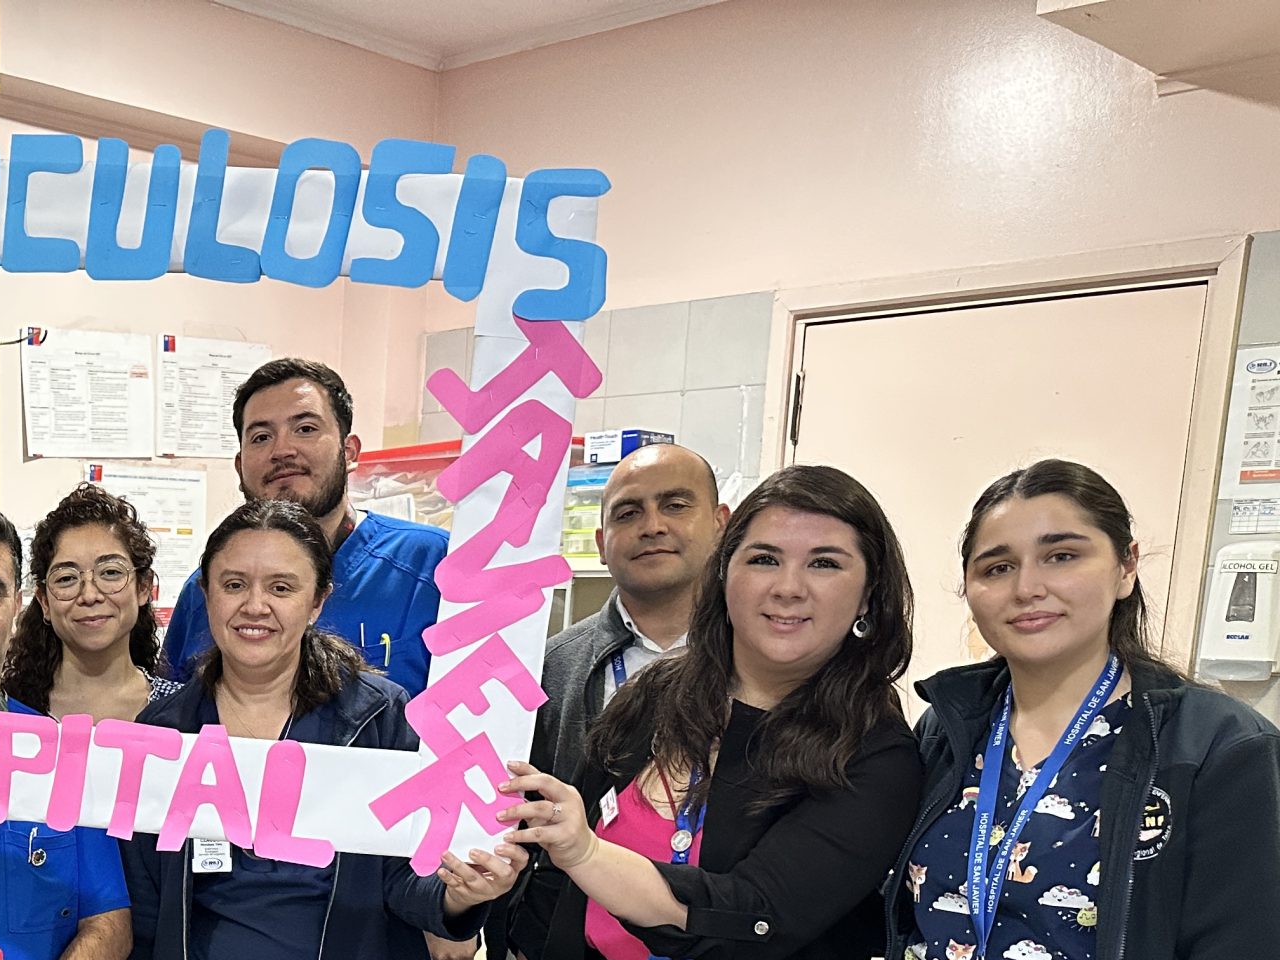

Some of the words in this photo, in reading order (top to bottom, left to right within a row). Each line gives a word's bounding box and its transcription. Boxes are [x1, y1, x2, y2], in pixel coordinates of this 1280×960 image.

[368, 312, 602, 877] JAVIER
[1063, 709, 1093, 745] HOSPITAL
[1088, 696, 1100, 709] DE
[1096, 680, 1111, 697] SAN
[976, 812, 989, 852] HOSPITAL
[973, 865, 982, 883] SAN
[974, 852, 983, 864] DE
[987, 872, 1002, 913] HOSPITAL
[996, 858, 1005, 870] DE
[1001, 839, 1013, 857] SAN
[1010, 809, 1028, 838] JAVIER
[972, 885, 980, 915] JAVIER
